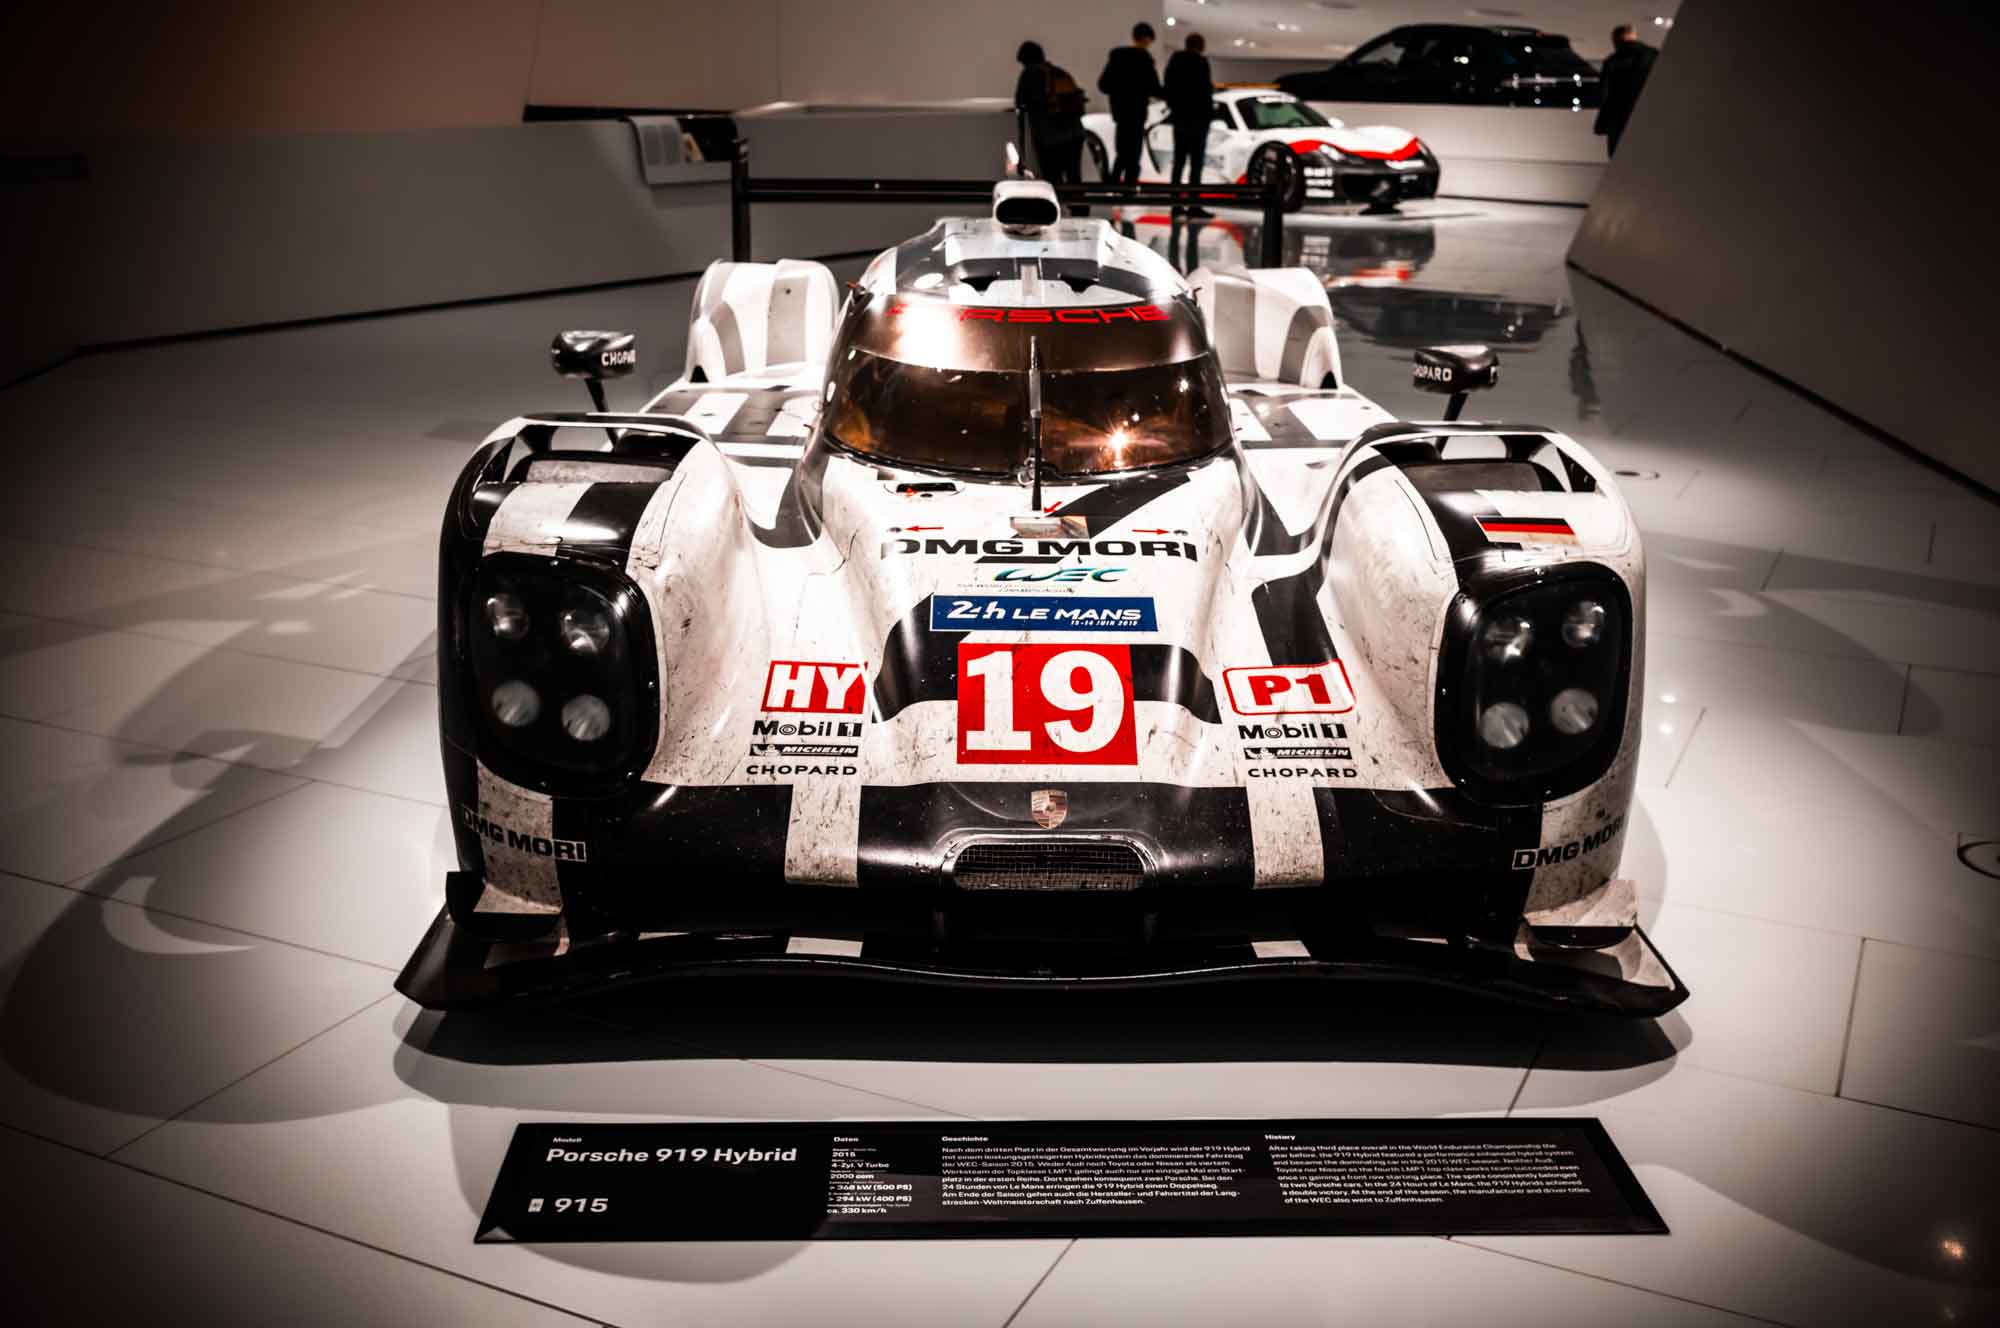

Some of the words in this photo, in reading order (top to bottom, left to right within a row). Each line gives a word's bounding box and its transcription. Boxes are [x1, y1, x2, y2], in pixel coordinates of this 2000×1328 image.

[1038, 540, 1199, 562] MORI
[994, 567, 1130, 583] WEC
[1012, 608, 1050, 620] LE
[1054, 608, 1142, 620] MANS
[765, 664, 866, 710] HY
[1247, 673, 1333, 706] P1
[964, 650, 1126, 753] 19
[752, 720, 832, 737] Mobil
[1239, 724, 1318, 740] Mobil
[780, 745, 857, 756] MICHELIN
[1276, 748, 1350, 759] MICHELIN
[746, 764, 858, 776] CHOPARD
[1248, 768, 1358, 778] CHOPARD
[508, 829, 586, 861] MORI
[1514, 841, 1580, 868] DMG
[546, 1148, 649, 1162] Porsche
[655, 1148, 708, 1162] 919
[714, 1148, 798, 1166] Hybrid
[554, 1198, 609, 1213] 915
